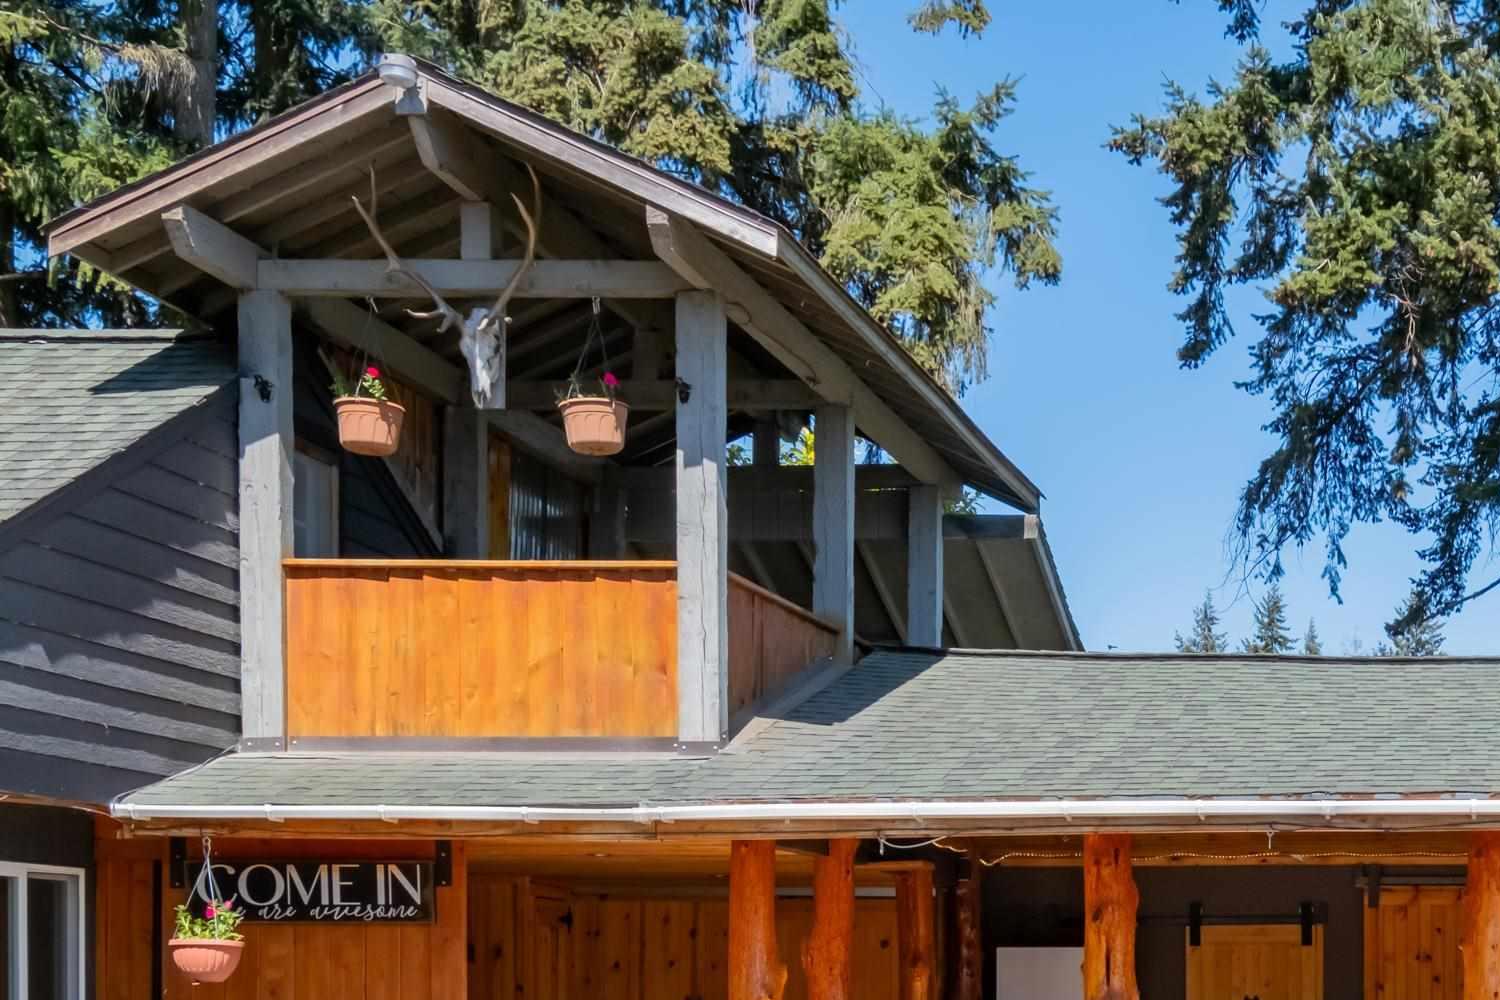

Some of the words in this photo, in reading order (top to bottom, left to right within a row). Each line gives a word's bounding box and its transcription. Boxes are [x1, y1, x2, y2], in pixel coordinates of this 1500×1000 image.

[196, 863, 360, 907] COME
[375, 863, 422, 906] IN
[258, 904, 297, 921] are
[309, 904, 418, 921] awesome
